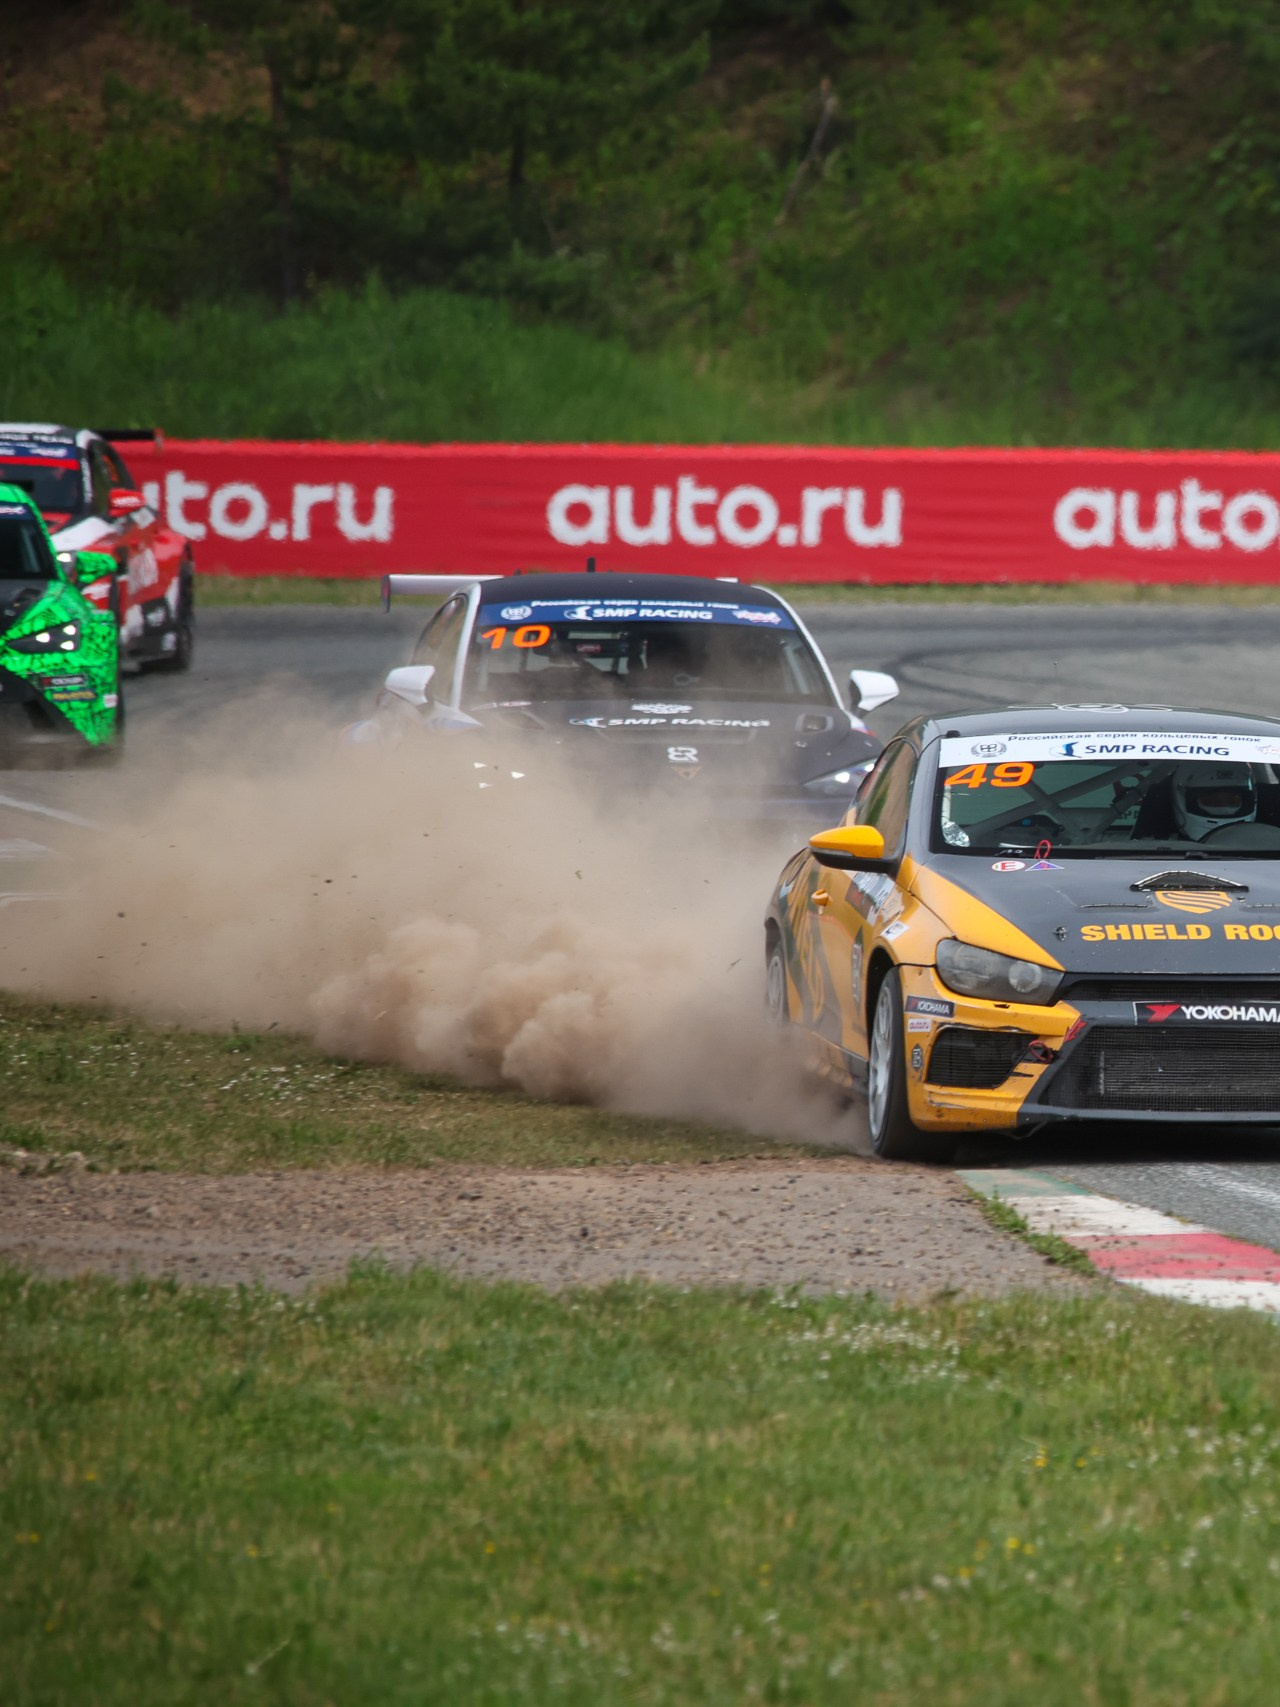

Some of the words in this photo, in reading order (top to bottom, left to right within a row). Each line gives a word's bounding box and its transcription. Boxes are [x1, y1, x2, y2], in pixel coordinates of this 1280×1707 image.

[142, 470, 395, 542] to.ru
[546, 475, 902, 547] auto.ru
[593, 608, 638, 618] SMP
[639, 608, 713, 620] RACING
[481, 624, 551, 649] 10
[608, 718, 667, 726] SMP
[671, 718, 771, 728] RACING
[1008, 733, 1092, 742] Российская
[1223, 735, 1262, 743] гонок
[1085, 744, 1136, 754] SMP
[1141, 744, 1230, 757] RACING
[944, 761, 1035, 789] 49
[1080, 923, 1211, 941] SHIELD
